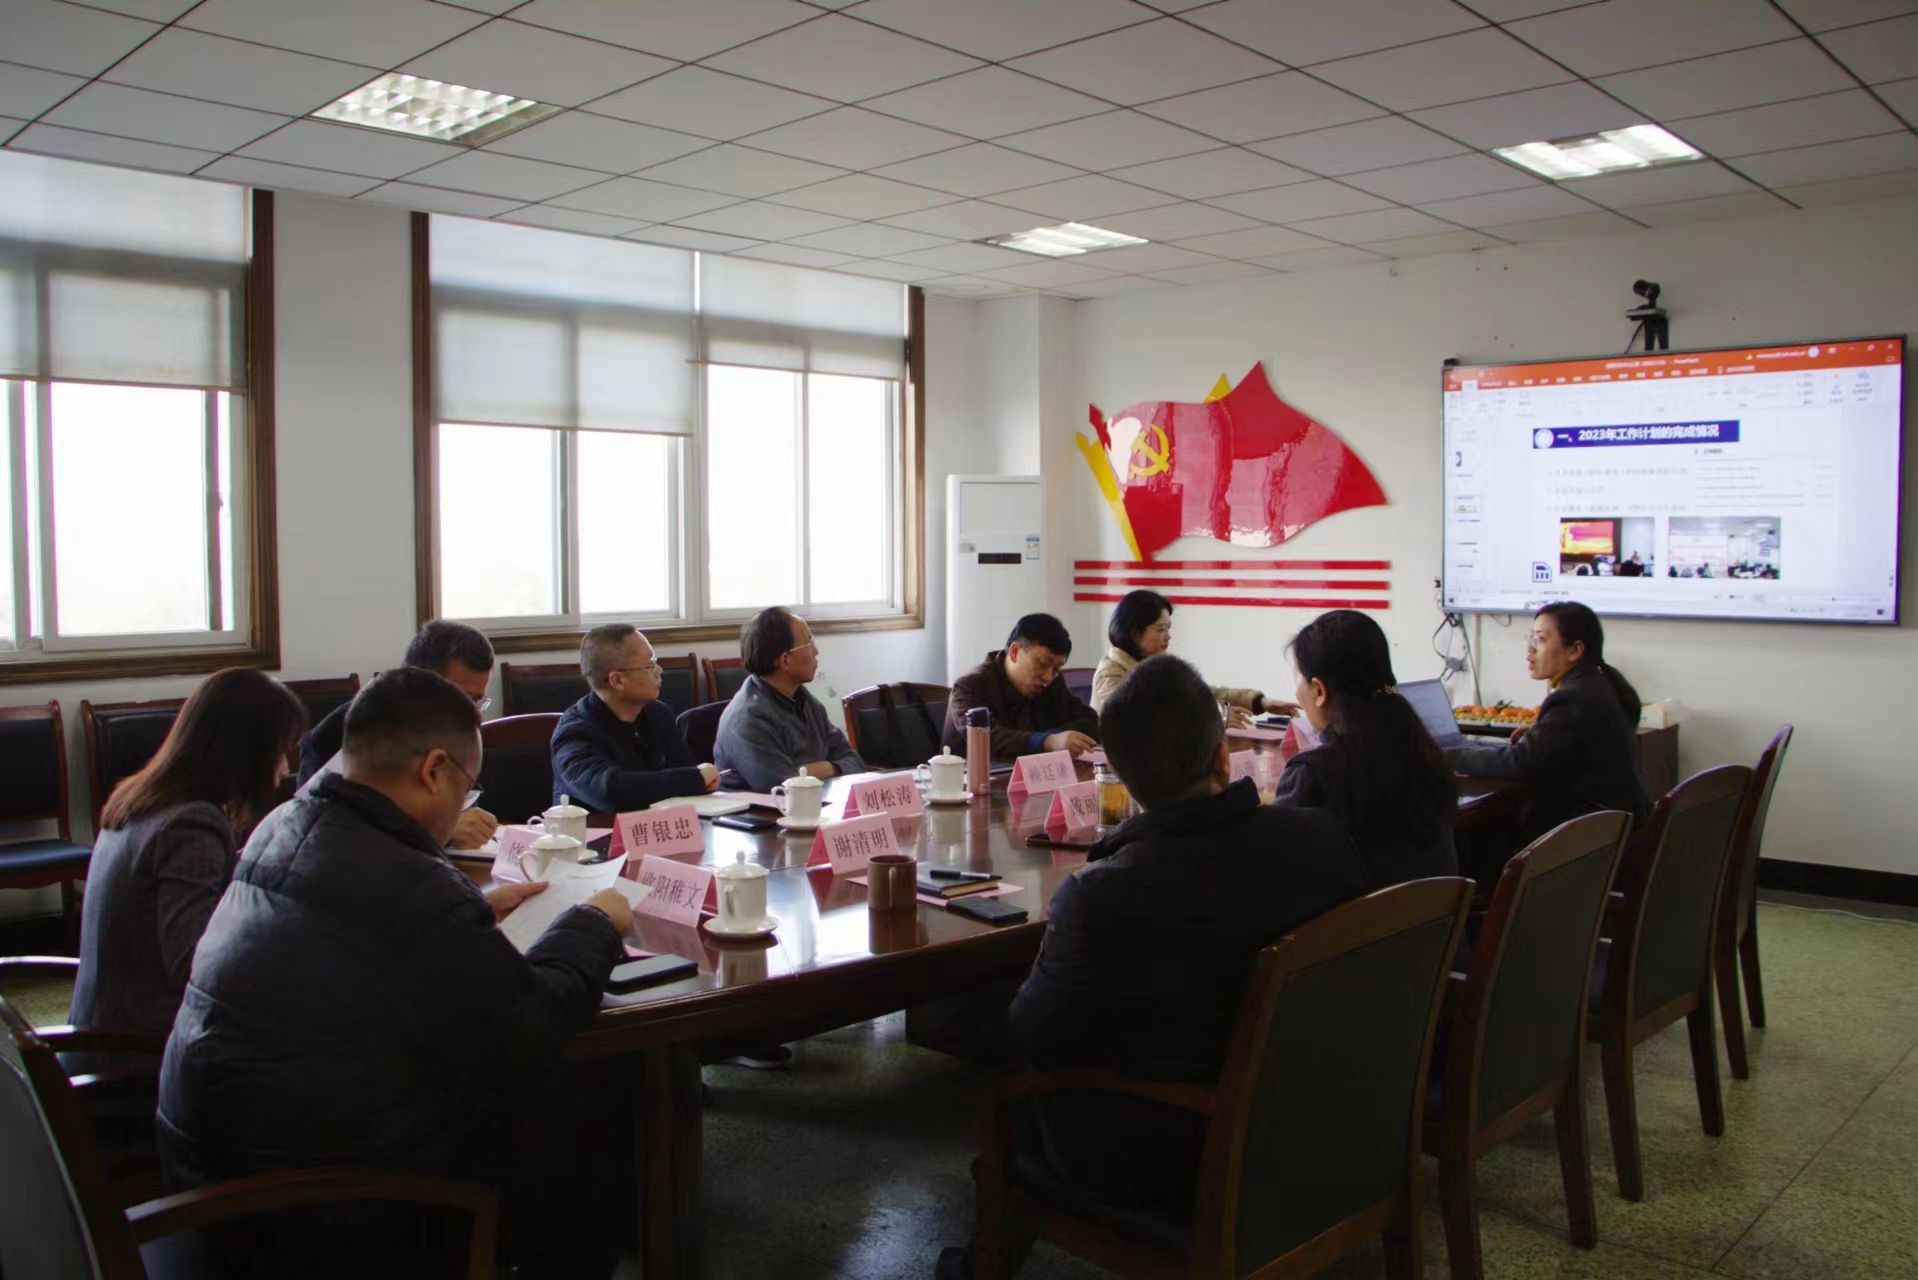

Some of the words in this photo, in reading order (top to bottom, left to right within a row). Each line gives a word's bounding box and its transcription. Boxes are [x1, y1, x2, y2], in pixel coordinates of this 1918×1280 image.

[864, 785, 912, 810] 刘松涛
[632, 817, 694, 847] 曹银忠
[832, 827, 889, 858] 谢清明
